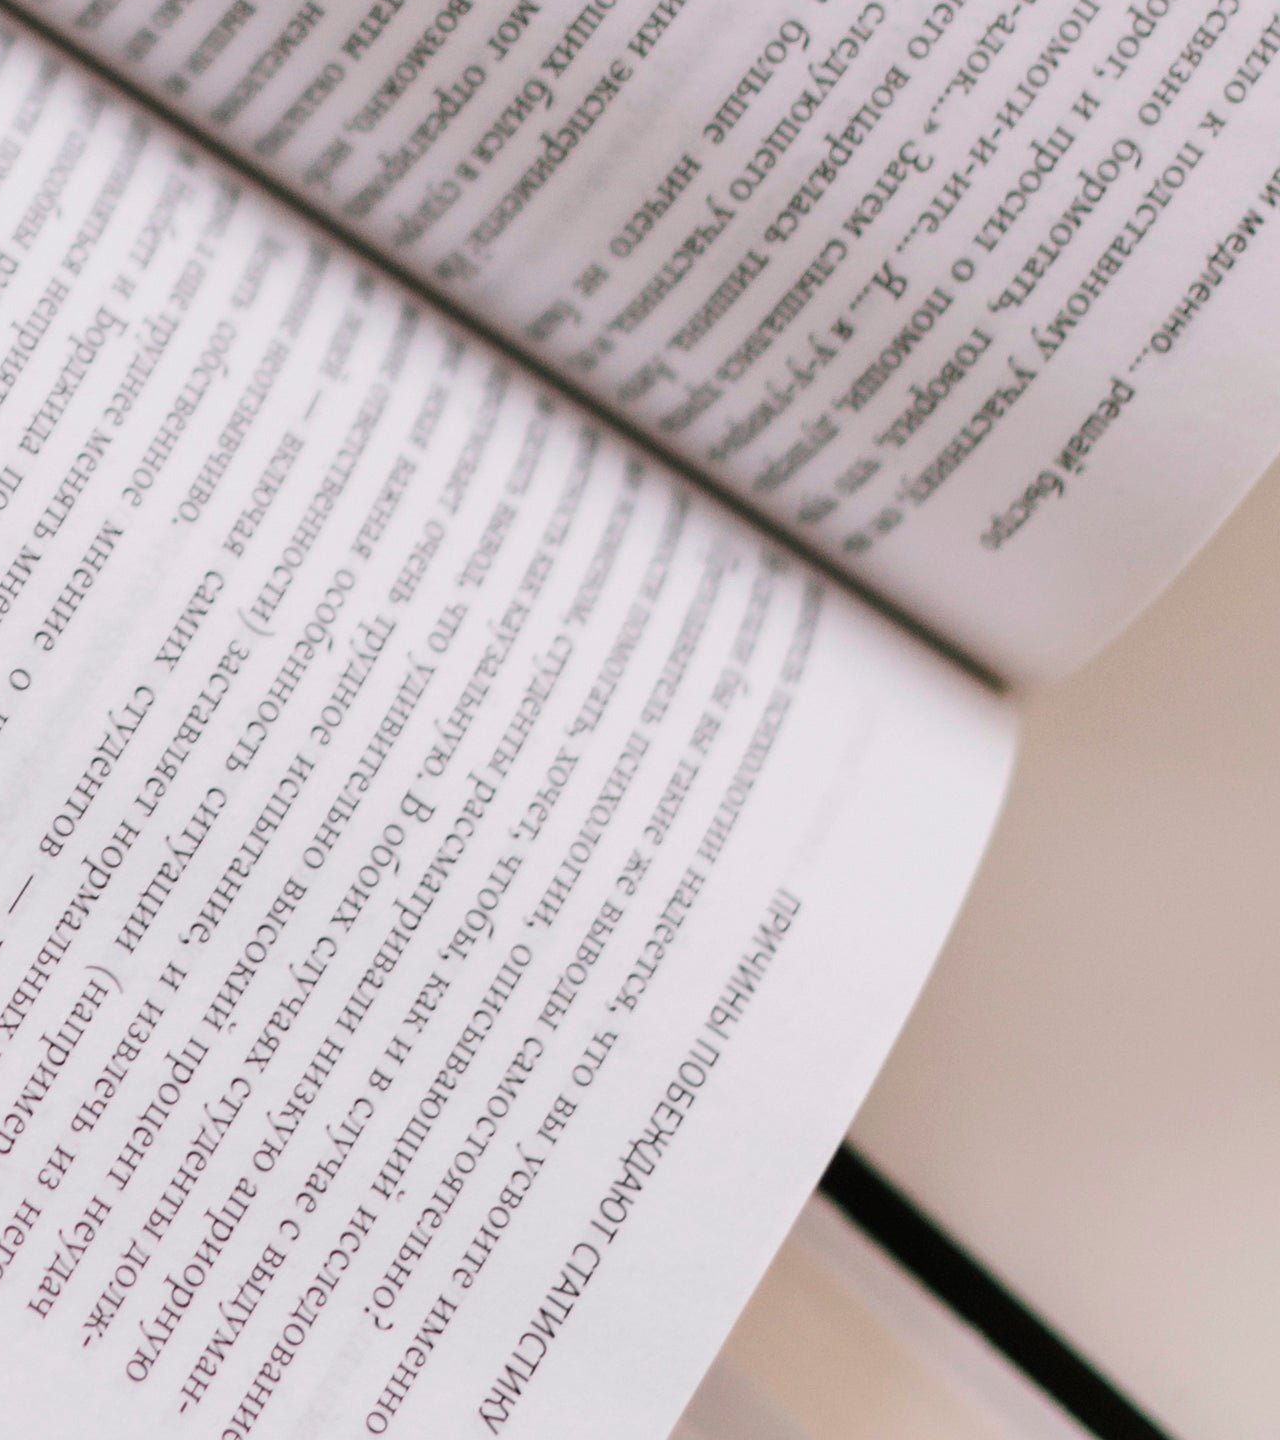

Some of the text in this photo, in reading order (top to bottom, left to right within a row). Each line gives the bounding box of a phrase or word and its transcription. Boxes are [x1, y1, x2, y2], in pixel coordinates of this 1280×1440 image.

[113, 785, 229, 956] ситуации
[703, 886, 804, 1042] ПРИЧИНЫ
[450, 1140, 548, 1291] усвоите
[588, 1037, 722, 1246] ПОБЕЖДАЮТ
[364, 1292, 460, 1437] именно
[476, 1240, 603, 1438] СТАТИСТИКУ
